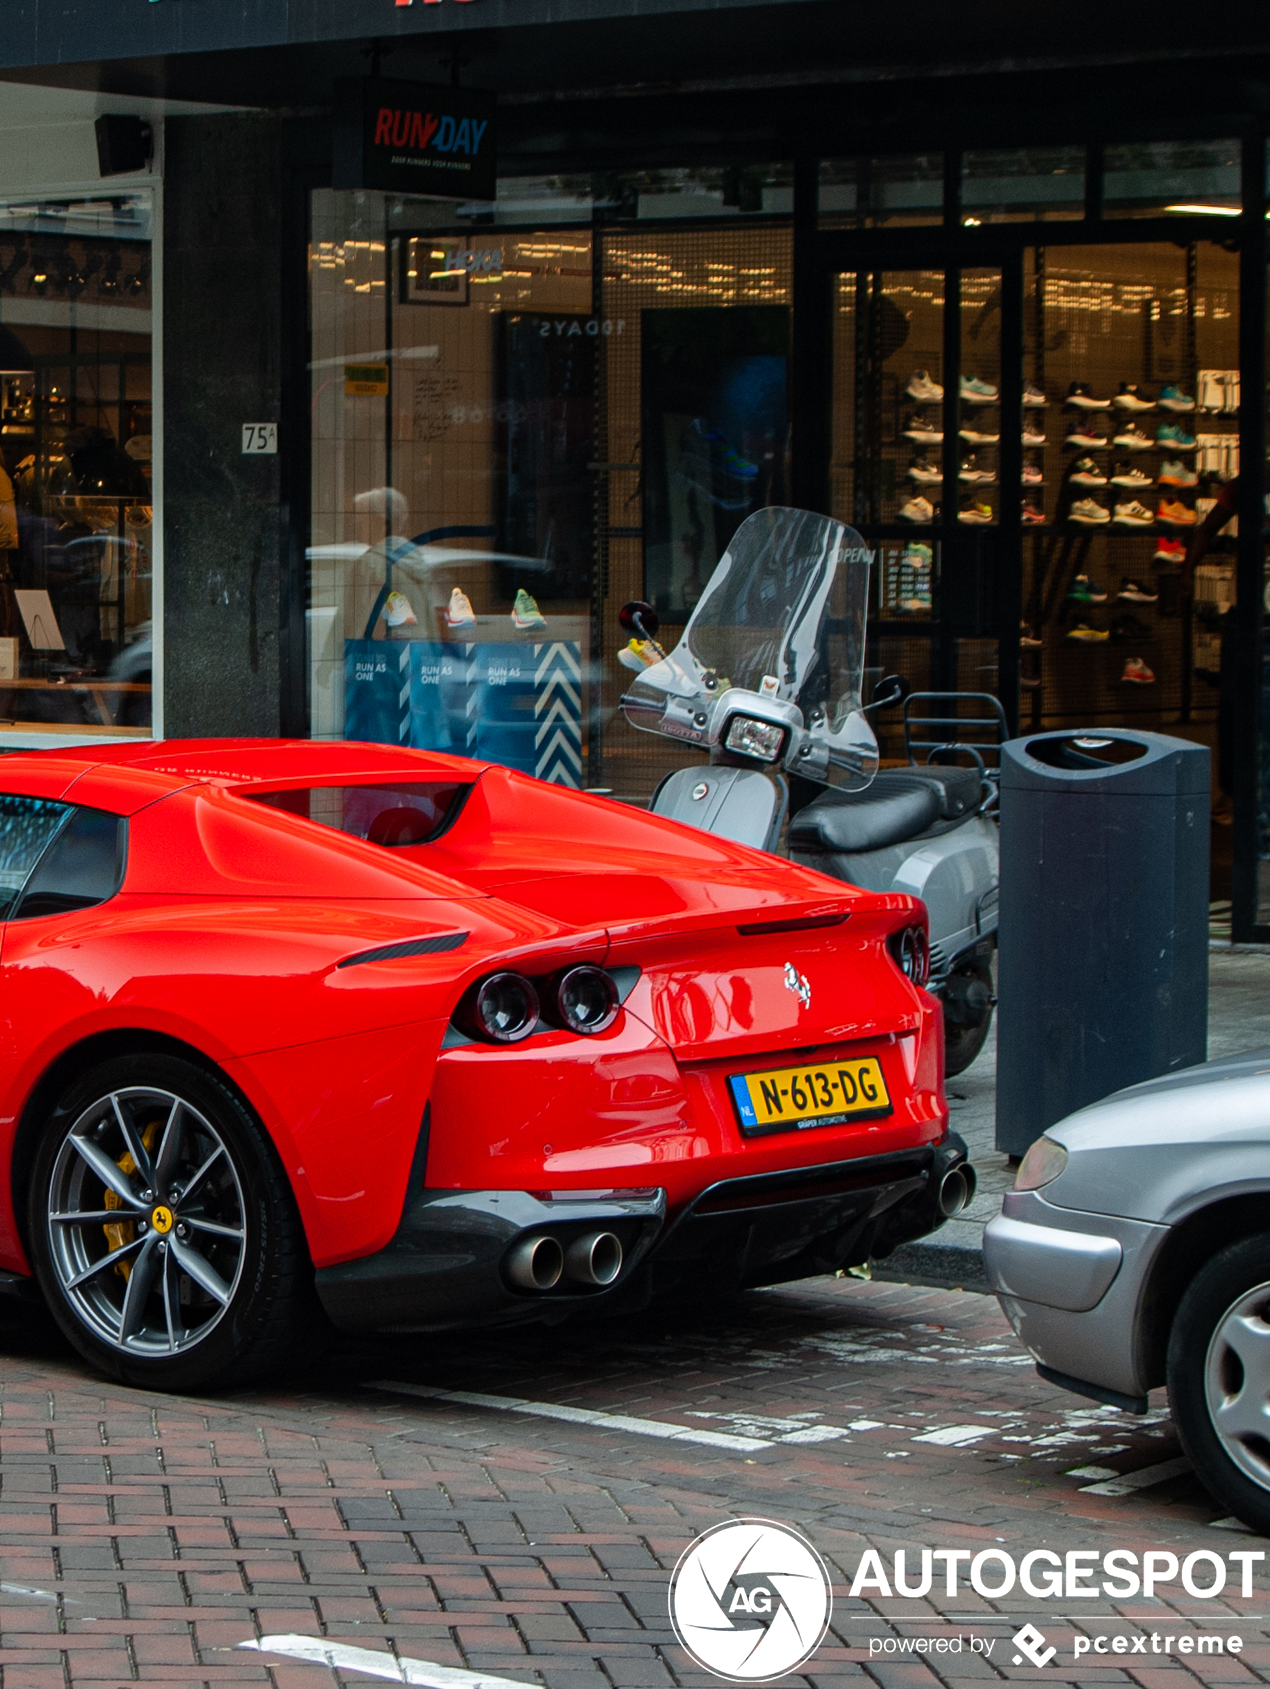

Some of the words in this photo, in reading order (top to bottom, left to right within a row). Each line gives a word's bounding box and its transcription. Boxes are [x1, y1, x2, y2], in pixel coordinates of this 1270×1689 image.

[355, 662, 374, 672] RUN
[375, 663, 386, 673] AS
[421, 665, 440, 675] RUN
[441, 666, 453, 676] AS
[488, 667, 507, 677] RUN
[509, 667, 521, 677] AS
[355, 672, 374, 681] ONE
[421, 675, 440, 685] ONE
[488, 676, 507, 686] ONE
[759, 1067, 878, 1115] N-613-DG
[741, 1106, 753, 1116] NL
